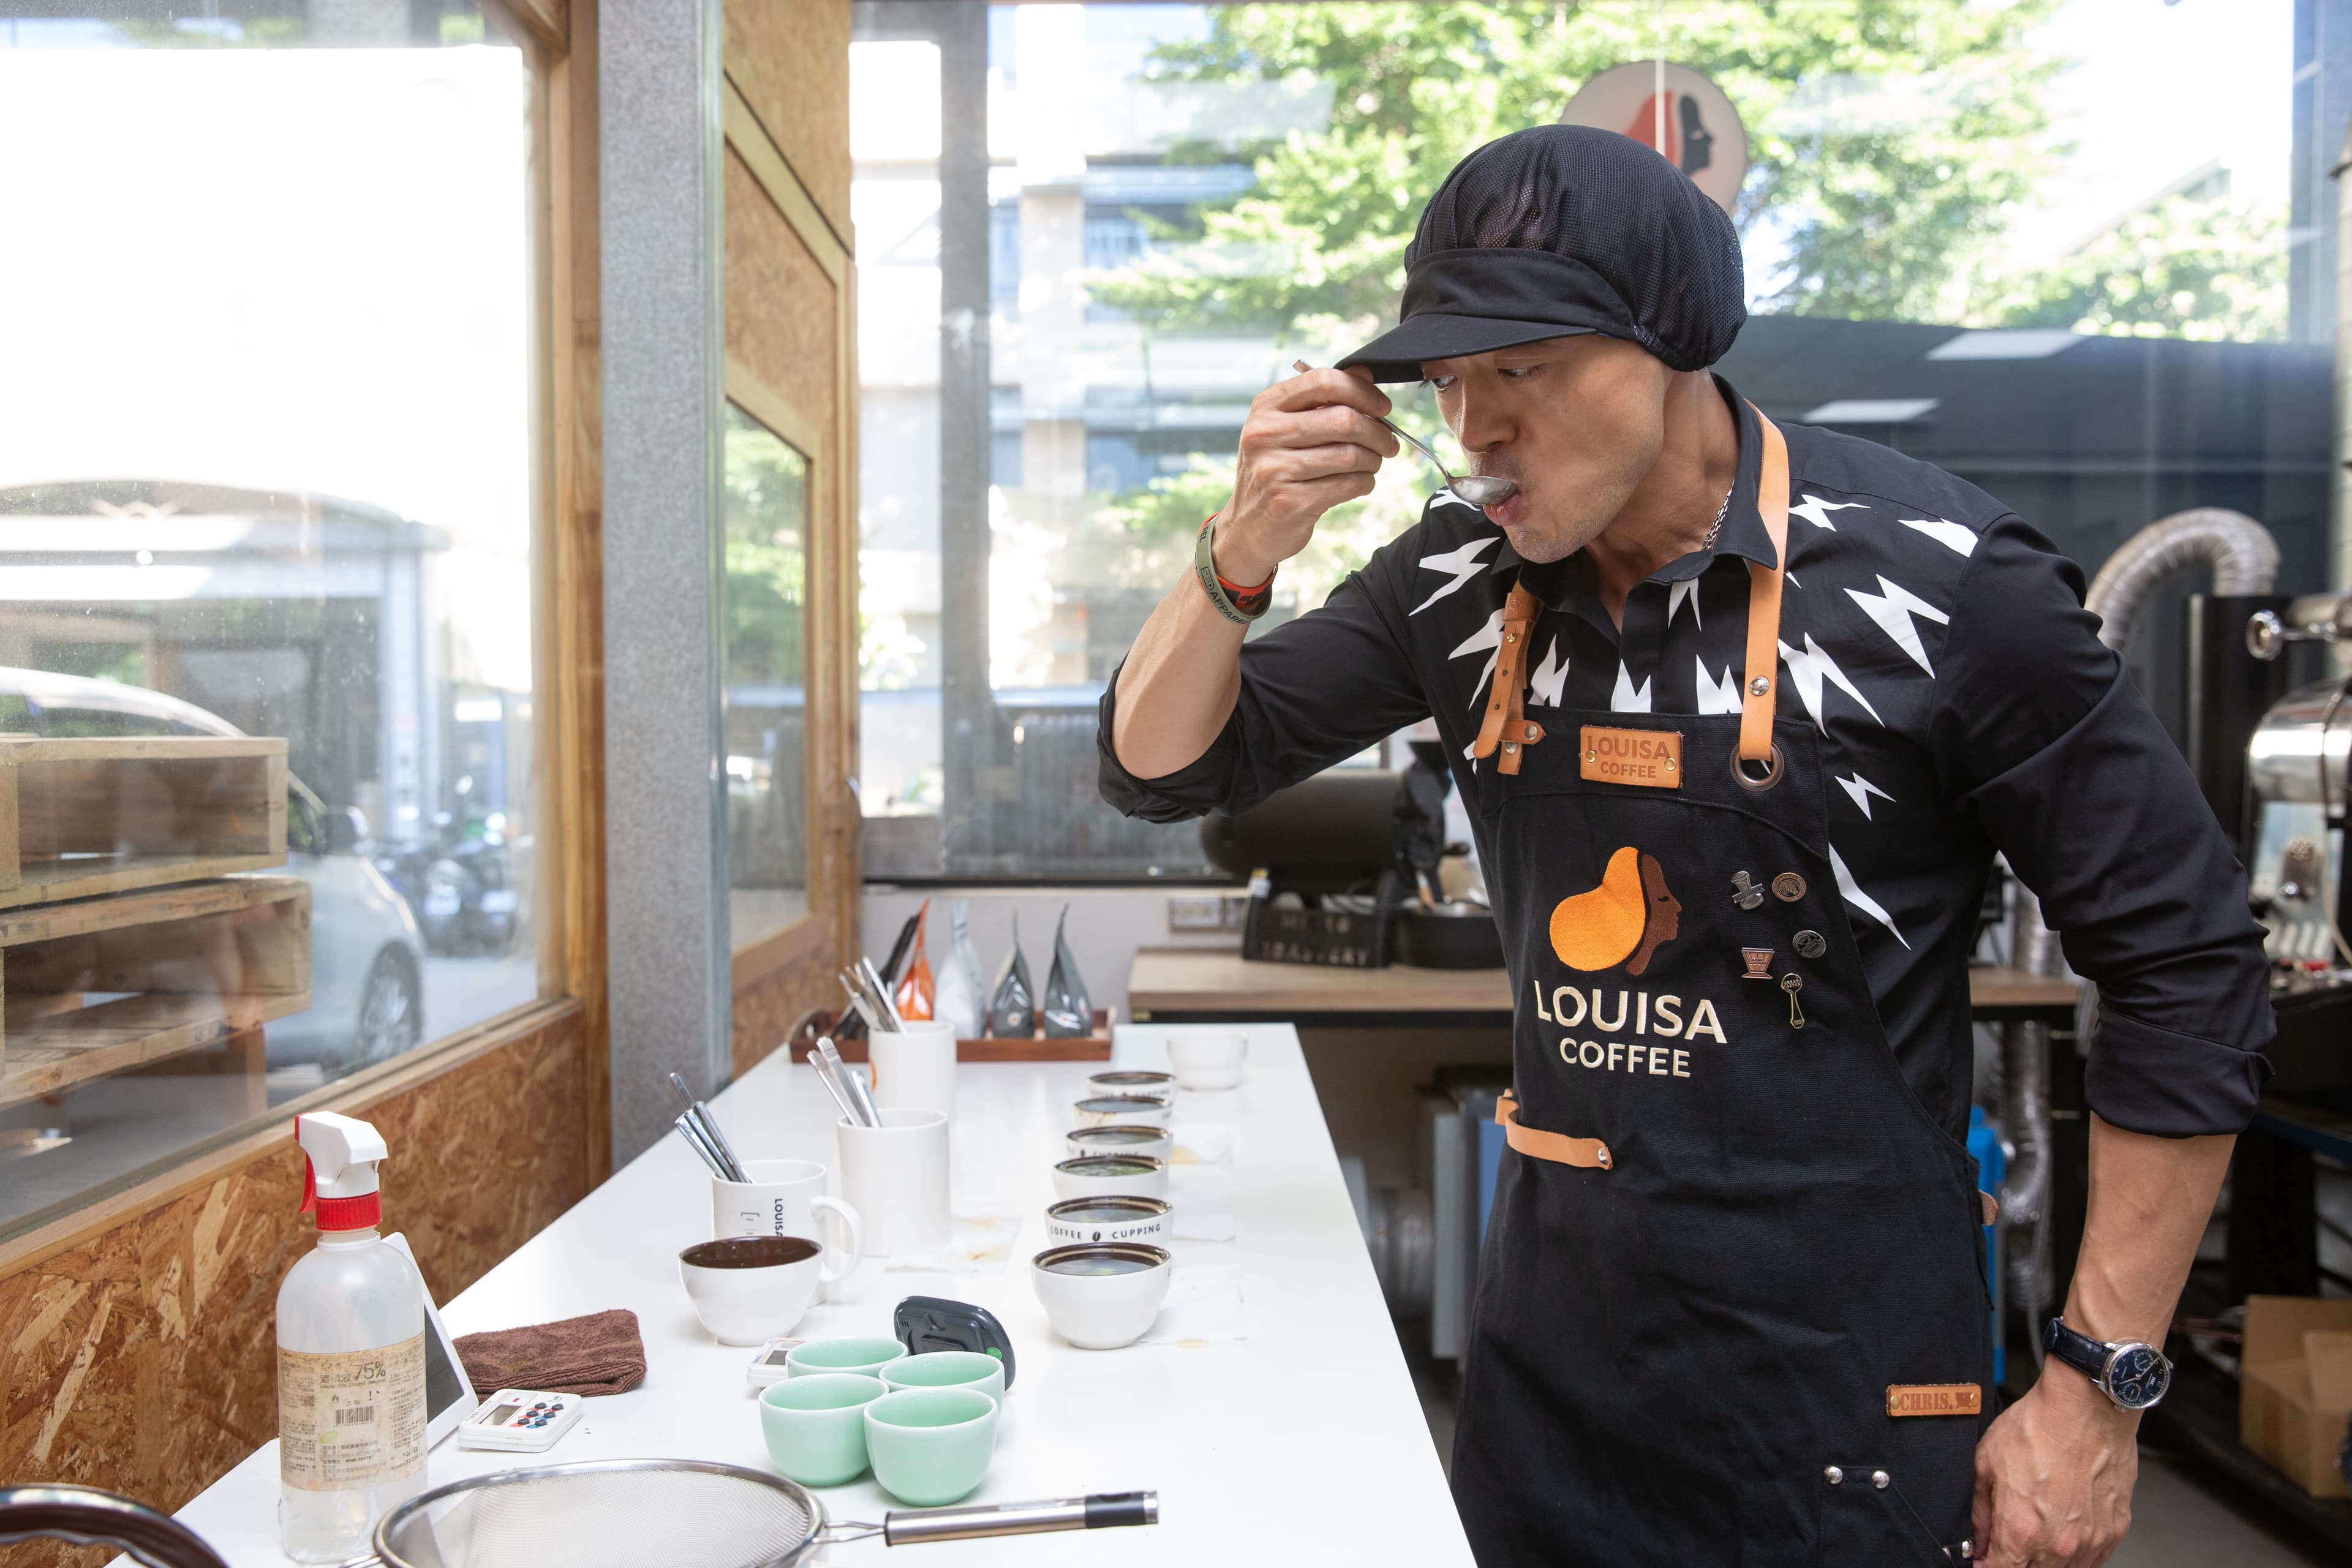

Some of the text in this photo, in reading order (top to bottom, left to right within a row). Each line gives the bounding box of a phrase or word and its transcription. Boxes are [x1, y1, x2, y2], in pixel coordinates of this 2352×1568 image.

[1588, 736, 1670, 760] LOUISA
[1600, 761, 1656, 778] COFFEE
[1534, 979, 1728, 1044] LOUISA
[1559, 1038, 1691, 1078] COFFEE
[1050, 1223, 1161, 1240] COFFEE CUPPING
[350, 1361, 386, 1381] 75%
[1900, 1393, 1953, 1411] CHRIS.
